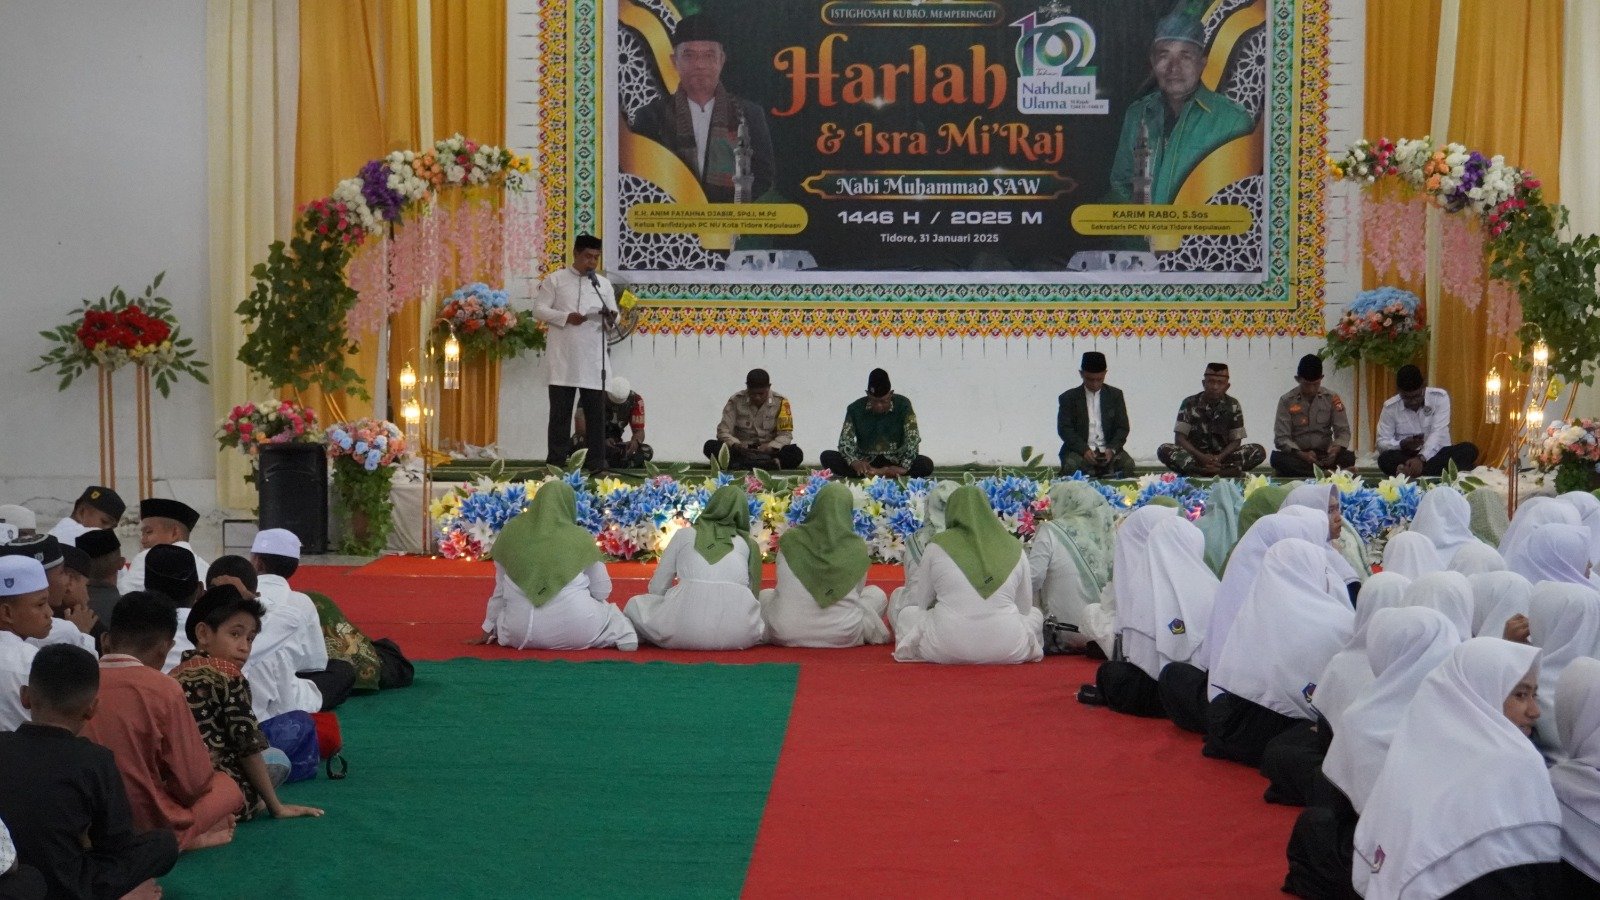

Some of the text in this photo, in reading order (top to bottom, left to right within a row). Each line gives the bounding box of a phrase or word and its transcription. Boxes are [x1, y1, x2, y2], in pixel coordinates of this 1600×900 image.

[831, 8, 890, 19] ISTIGHOSAH
[892, 8, 928, 19] KUBRO,
[771, 33, 1007, 116] Harlah
[1022, 82, 1091, 95] Nahdlatul
[1022, 96, 1067, 109] Ulama
[816, 121, 845, 155] &
[854, 122, 928, 155] Isra
[835, 175, 1041, 196] Nabi Muhammad SAW
[837, 211, 1042, 224] 1446 H / 2025 M
[1112, 211, 1209, 220] KARIM RABO, S.Sos
[1193, 224, 1231, 232] Kepulauan
[880, 233, 999, 244] Tidore, 31 Januari 2025
